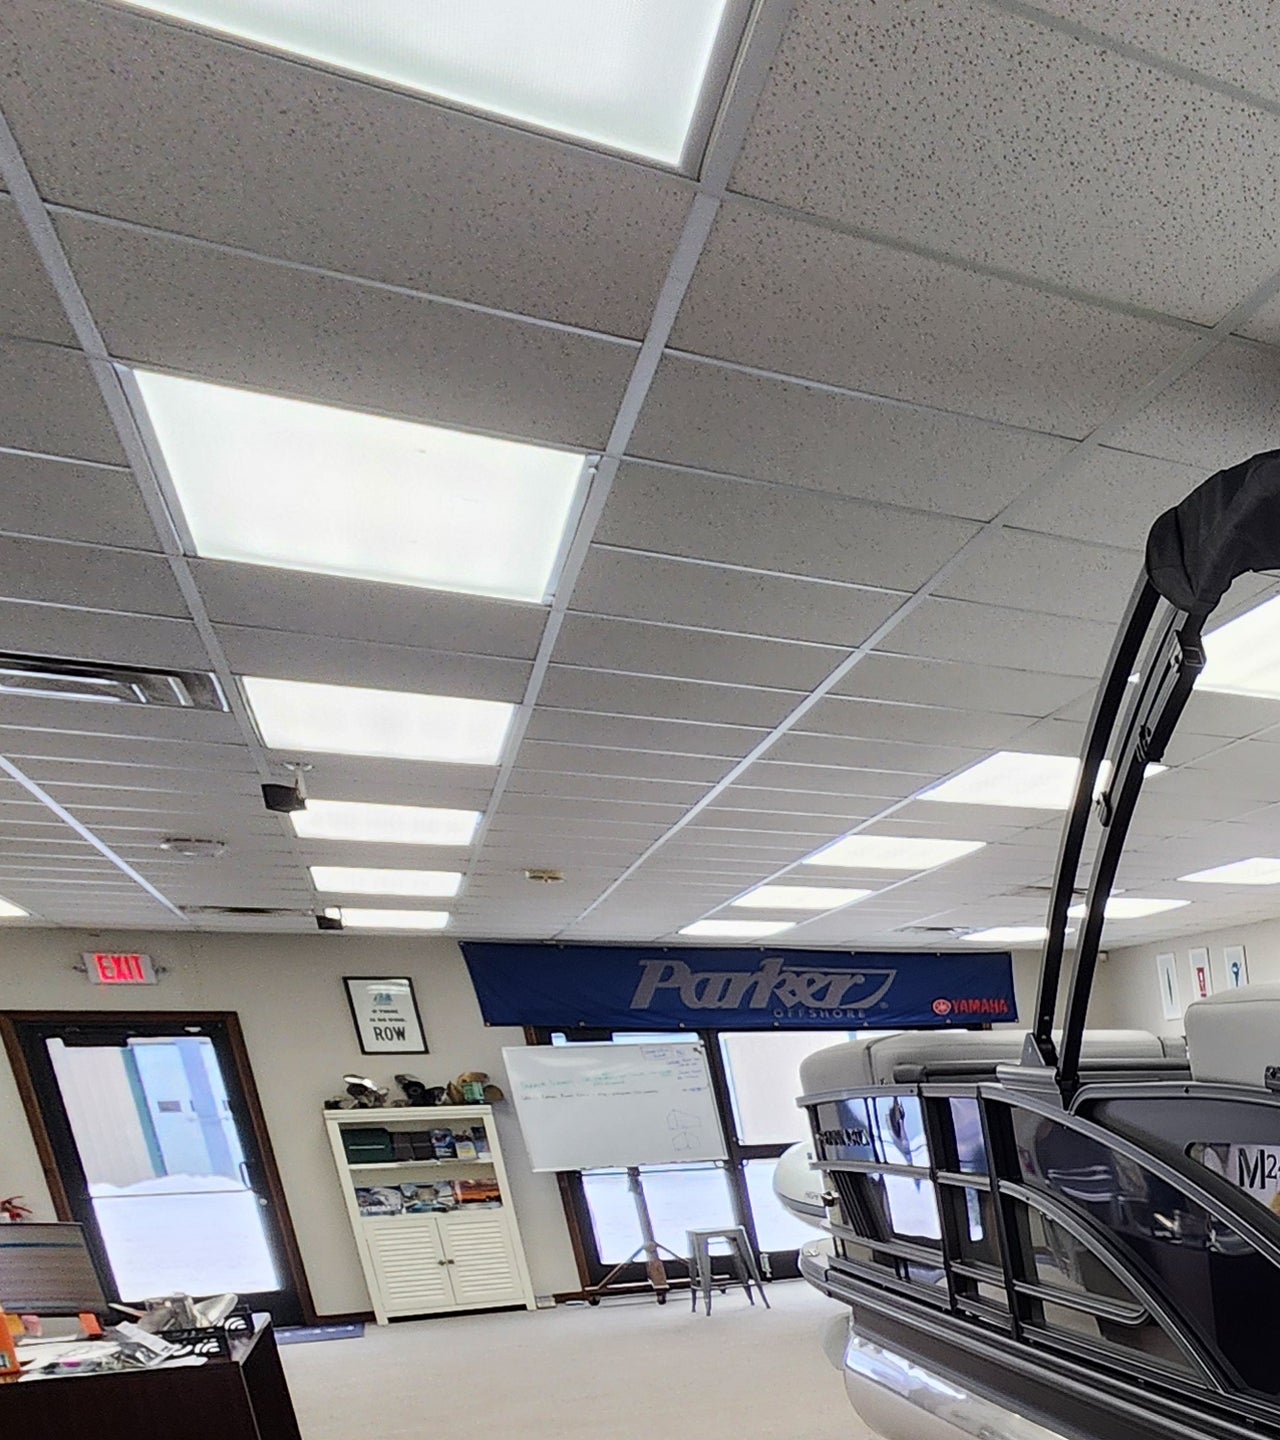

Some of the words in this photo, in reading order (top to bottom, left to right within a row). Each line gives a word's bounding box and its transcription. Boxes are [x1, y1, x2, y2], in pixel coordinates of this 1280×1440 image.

[96, 954, 145, 983] EXIT
[629, 957, 867, 1010] Parker
[772, 1008, 867, 1018] OFFSHORE
[952, 999, 1009, 1014] YAMAHA
[373, 1026, 406, 1041] ROW
